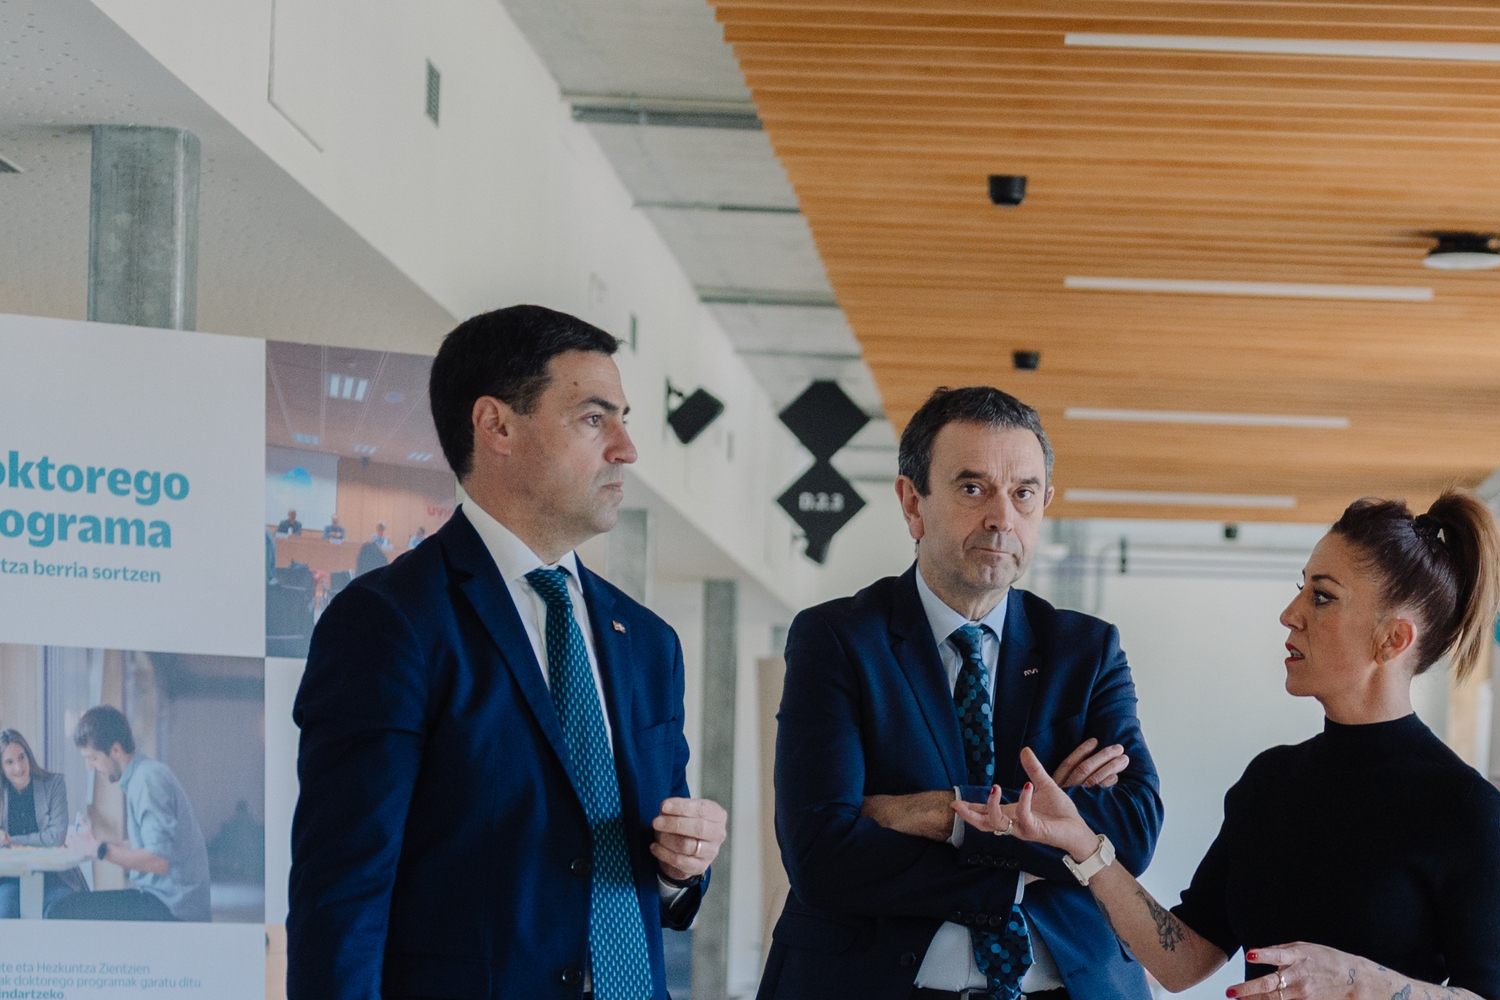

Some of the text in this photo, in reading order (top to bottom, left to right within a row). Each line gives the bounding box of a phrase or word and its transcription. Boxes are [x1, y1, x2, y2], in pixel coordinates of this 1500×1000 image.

[0, 508, 172, 548] ograma
[0, 558, 161, 584] tza berria sortzen
[15, 962, 34, 974] eta
[36, 961, 96, 974] Hezkuntza
[98, 961, 150, 974] Zientzien
[14, 975, 74, 989] doktorego
[76, 976, 137, 990] programak
[140, 978, 176, 990] garatu
[179, 976, 201, 988] ditu
